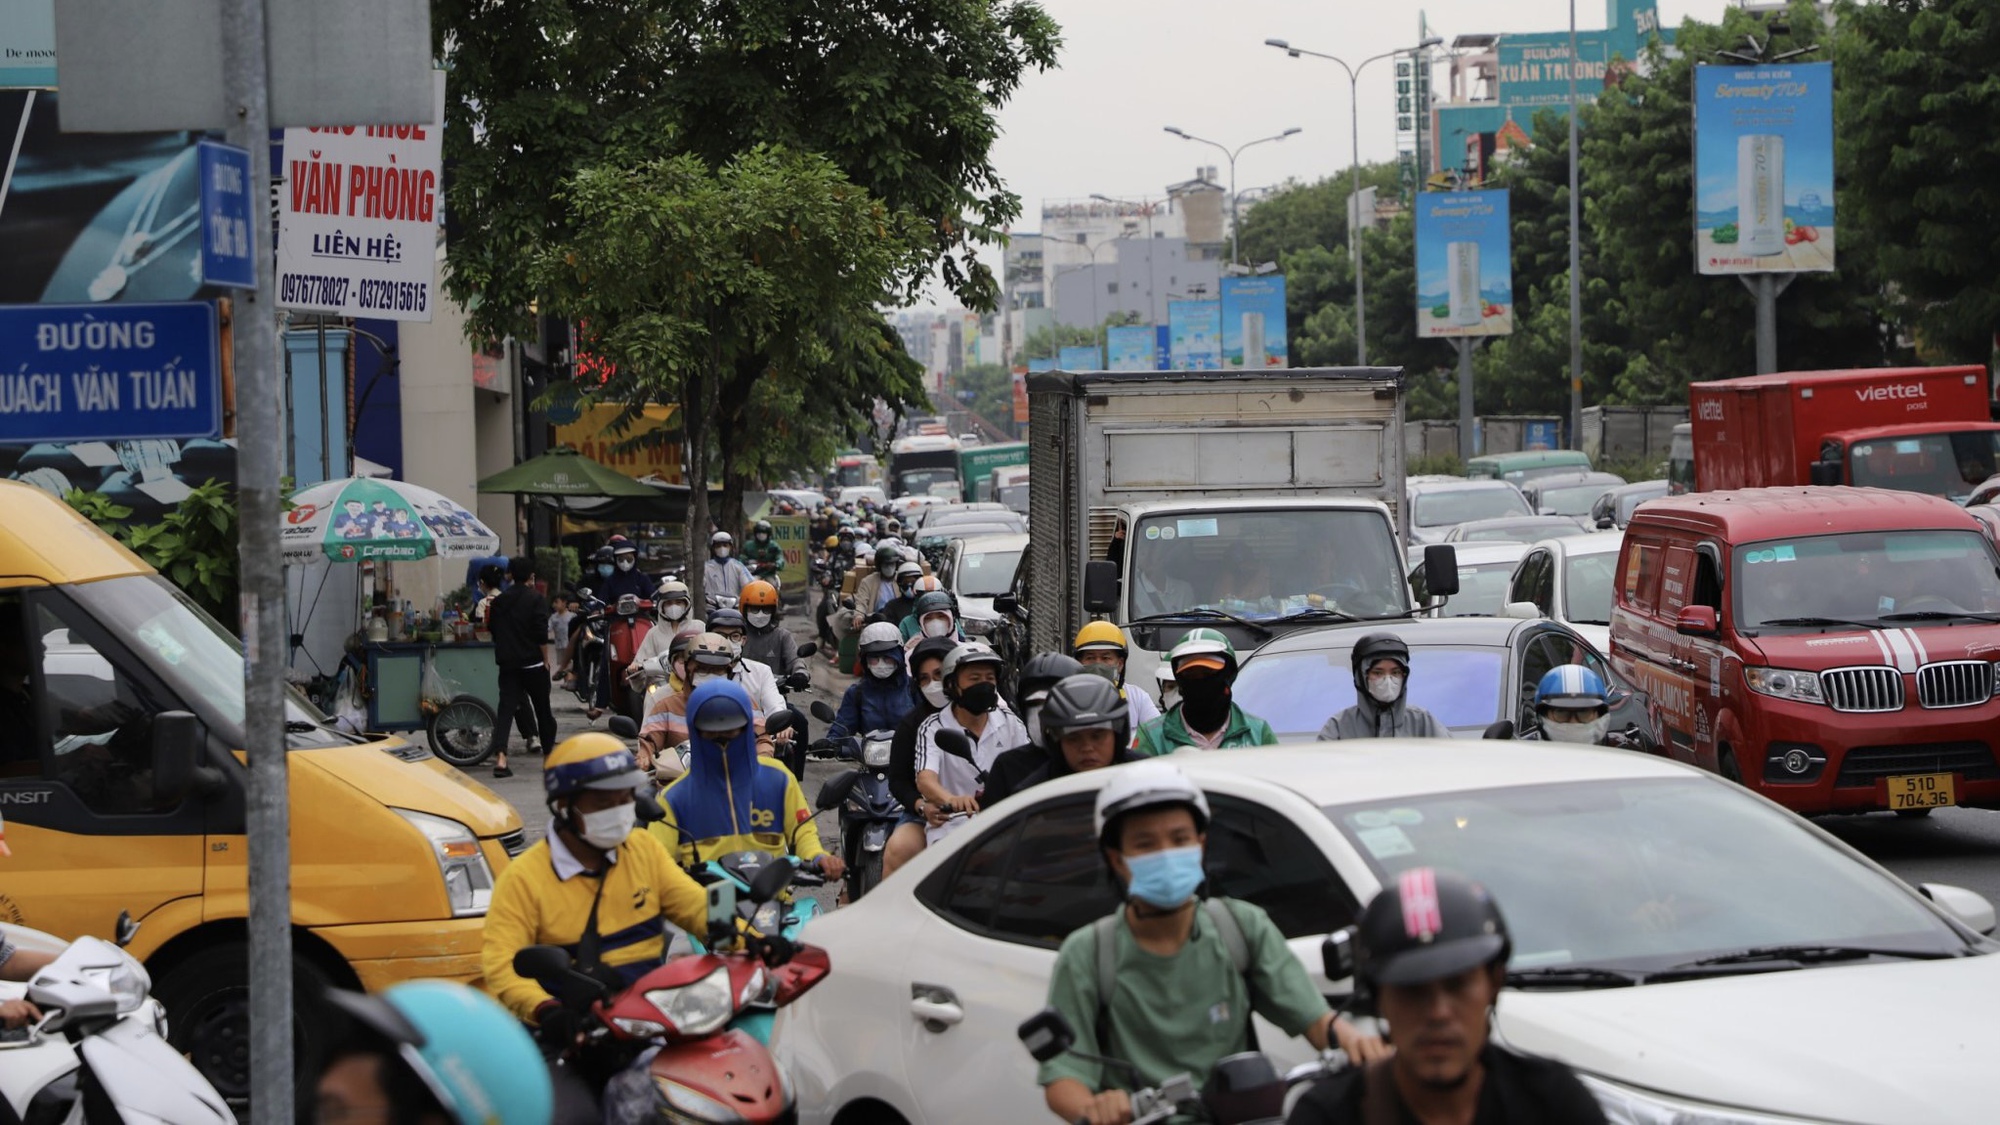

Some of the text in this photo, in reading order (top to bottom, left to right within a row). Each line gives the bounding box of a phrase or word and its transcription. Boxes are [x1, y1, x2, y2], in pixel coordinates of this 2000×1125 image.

[290, 150, 342, 215] VĂN
[347, 154, 435, 223] PHÒNG
[313, 229, 402, 264] LIÊN HỆ:
[281, 273, 350, 306] 0976778027
[359, 278, 427, 312] 0372915615
[36, 313, 156, 351] ĐƯỜNG
[0, 356, 197, 413] UÁCH VĂN TUẤN
[1855, 382, 1927, 401] viettel
[1906, 401, 1928, 411] post
[363, 545, 416, 556] Carabao
[1906, 776, 1936, 792] 51D
[0, 791, 53, 805] NSIT
[1896, 791, 1949, 808] 704.36
[749, 801, 775, 828] be
